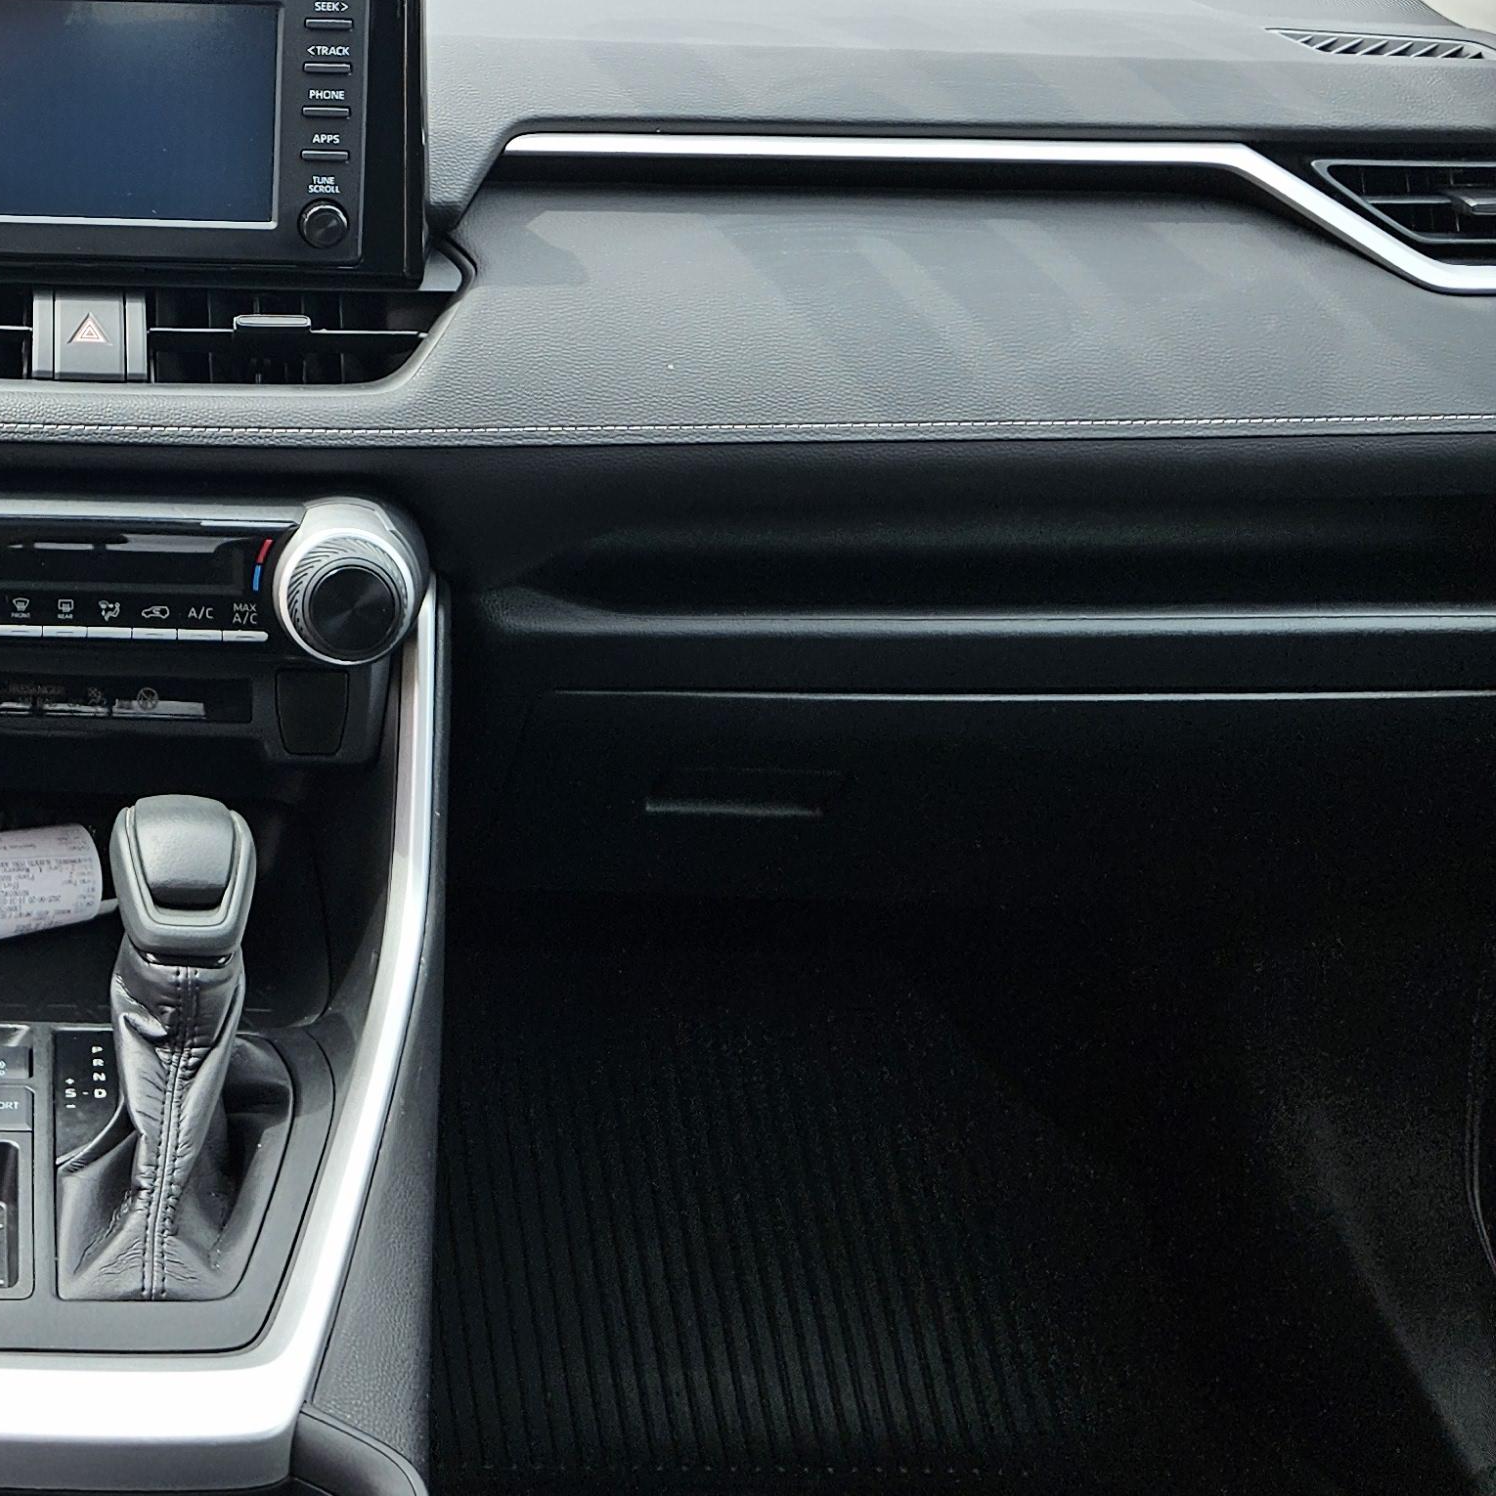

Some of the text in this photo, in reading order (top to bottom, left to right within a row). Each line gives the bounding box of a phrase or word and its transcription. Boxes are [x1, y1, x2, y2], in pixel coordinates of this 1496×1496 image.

[308, 89, 345, 100] PHONE
[312, 133, 340, 144] APPS
[312, 175, 335, 185] TUNE
[308, 184, 341, 194] SCROLL
[187, 606, 215, 620] A/C
[232, 602, 257, 613] MAX
[232, 612, 258, 625] A/C
[92, 1046, 103, 1054] P
[92, 1058, 104, 1067] R
[92, 1072, 106, 1082] N
[65, 1088, 77, 1099] S
[94, 1088, 107, 1099] D
